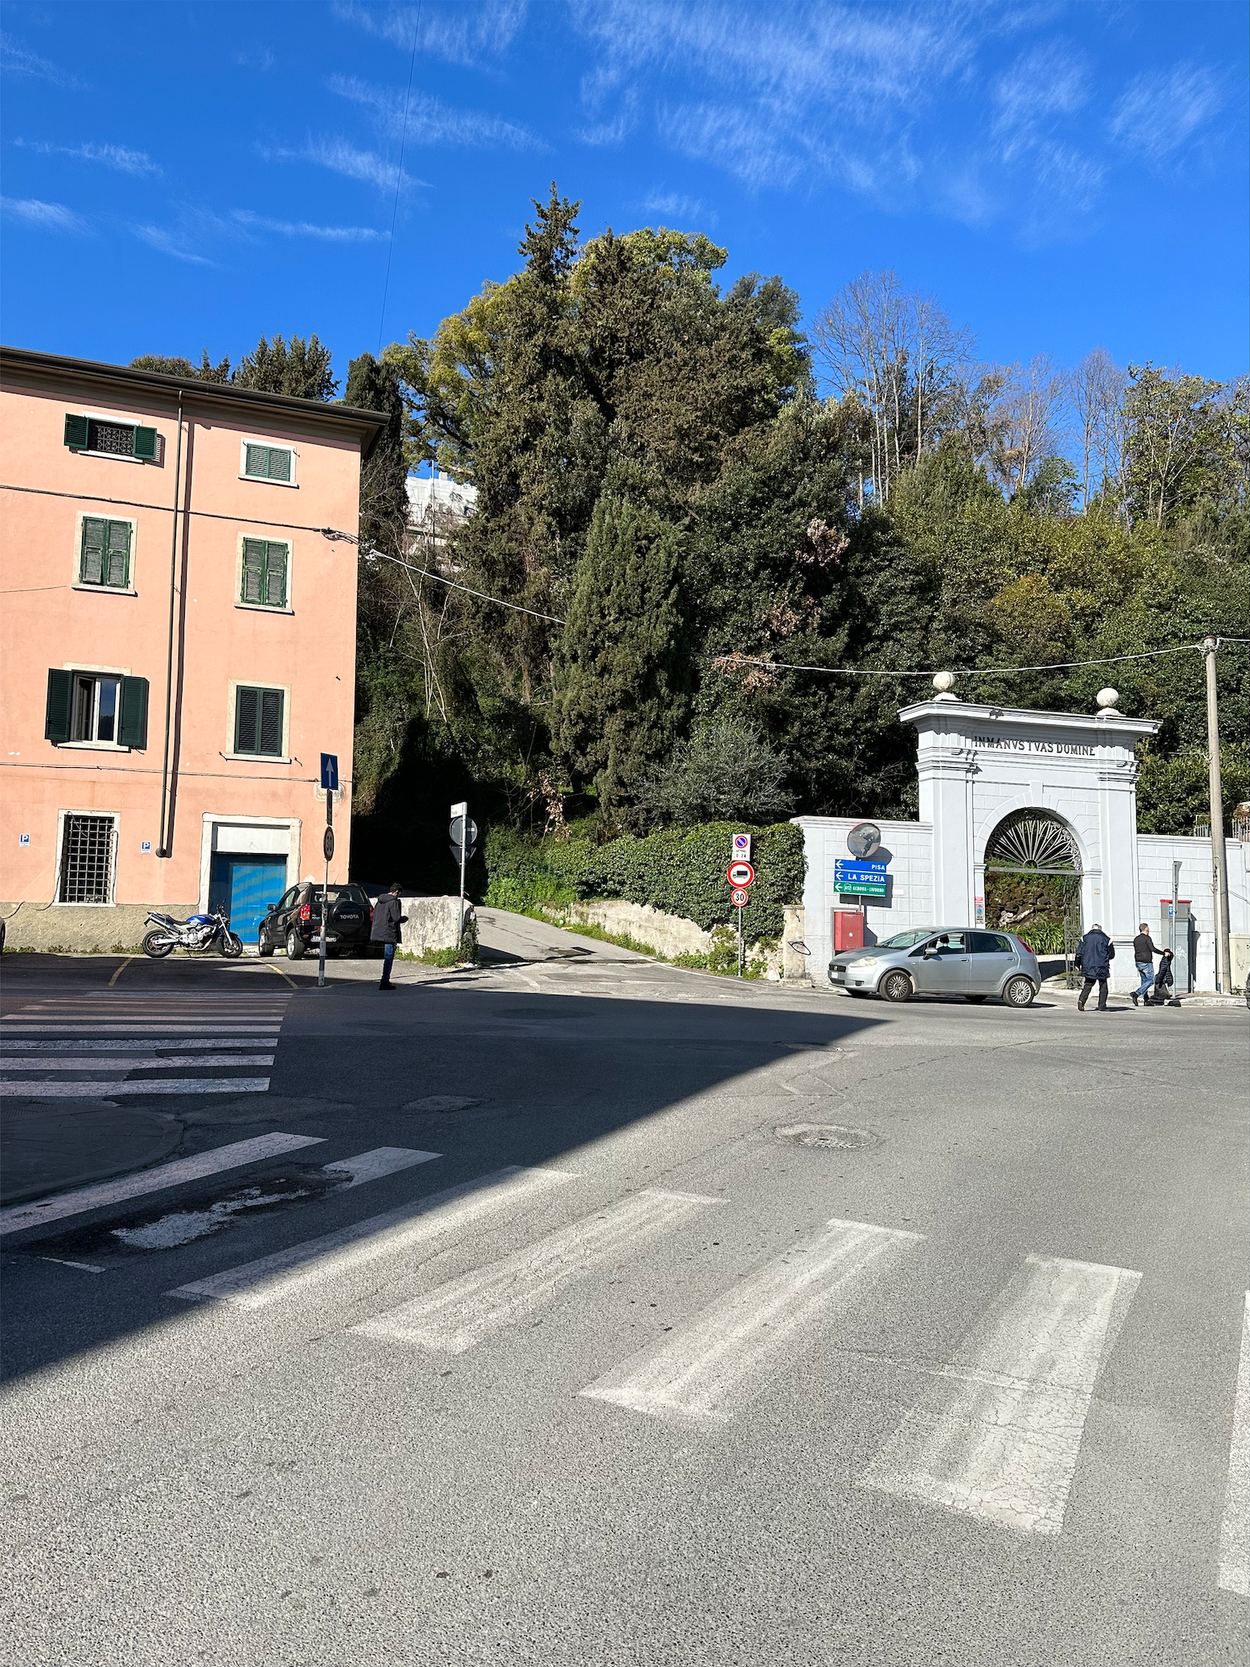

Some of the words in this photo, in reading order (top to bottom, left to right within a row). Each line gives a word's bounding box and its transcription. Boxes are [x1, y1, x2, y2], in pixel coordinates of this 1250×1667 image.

[974, 736, 986, 748] IN
[987, 737, 1025, 751] MANVS
[1028, 740, 1053, 753] TVAS
[1056, 743, 1096, 756] DOMINE
[735, 893, 744, 901] 30
